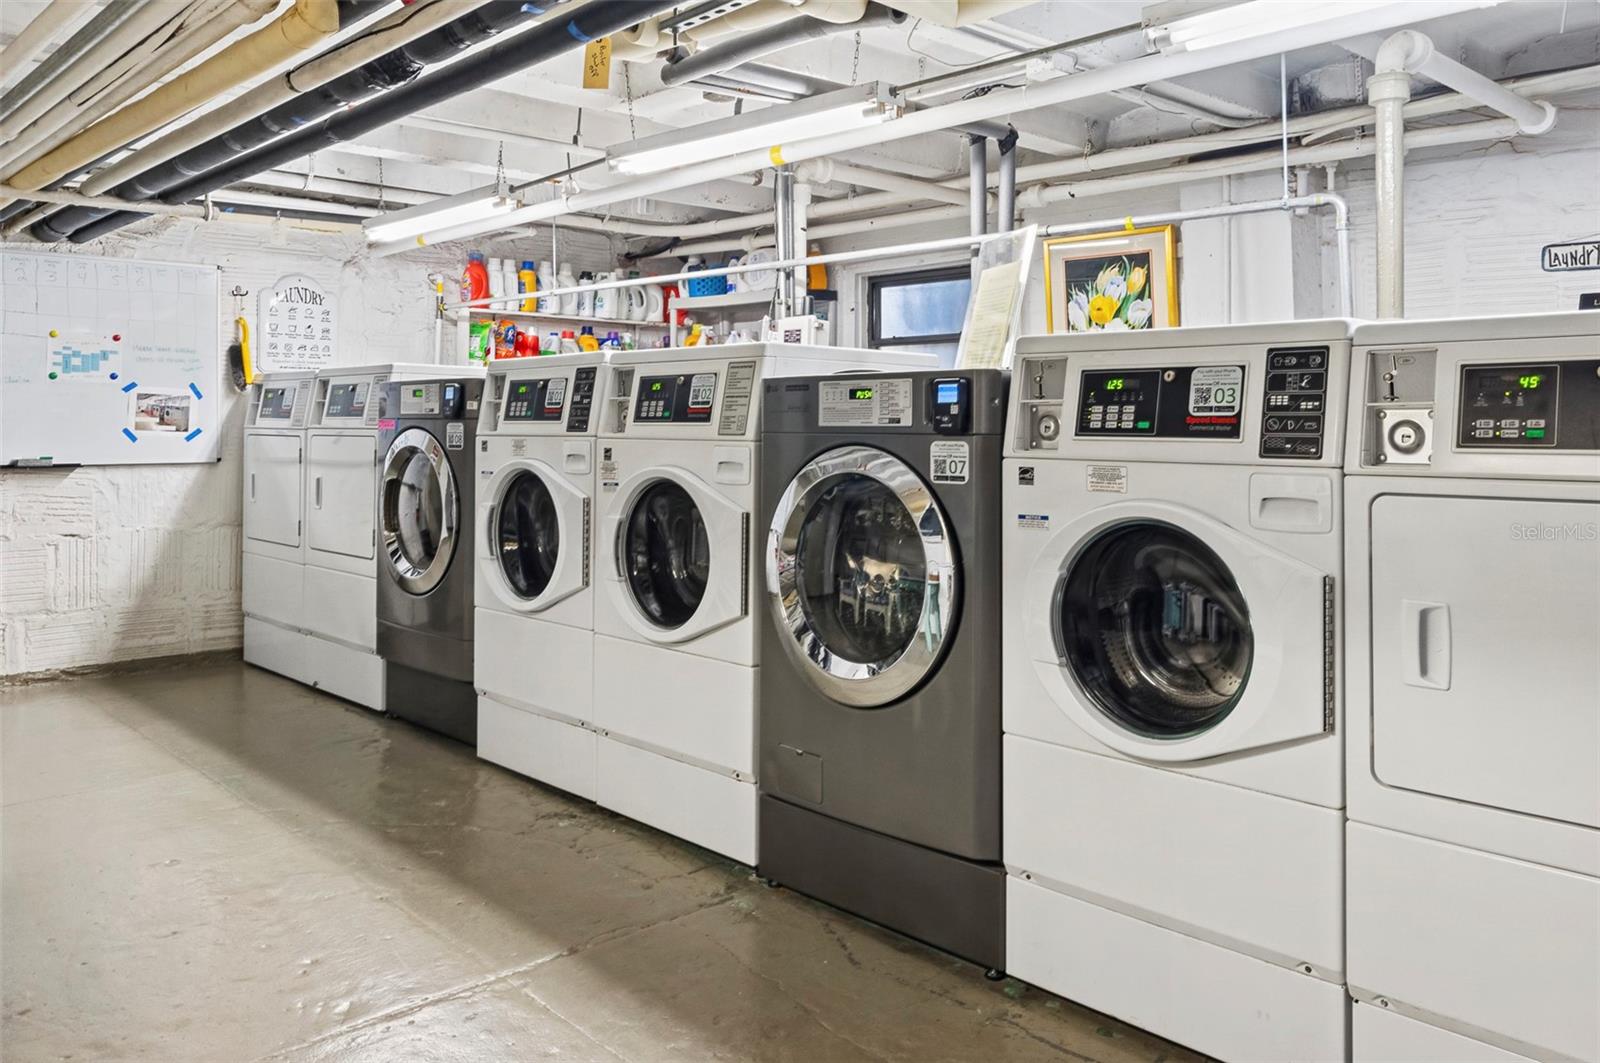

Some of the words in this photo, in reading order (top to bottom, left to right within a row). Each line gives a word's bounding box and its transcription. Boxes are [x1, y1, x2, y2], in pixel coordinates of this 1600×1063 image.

[700, 388, 712, 399] 02
[1214, 387, 1236, 404] 03
[949, 460, 966, 474] 07
